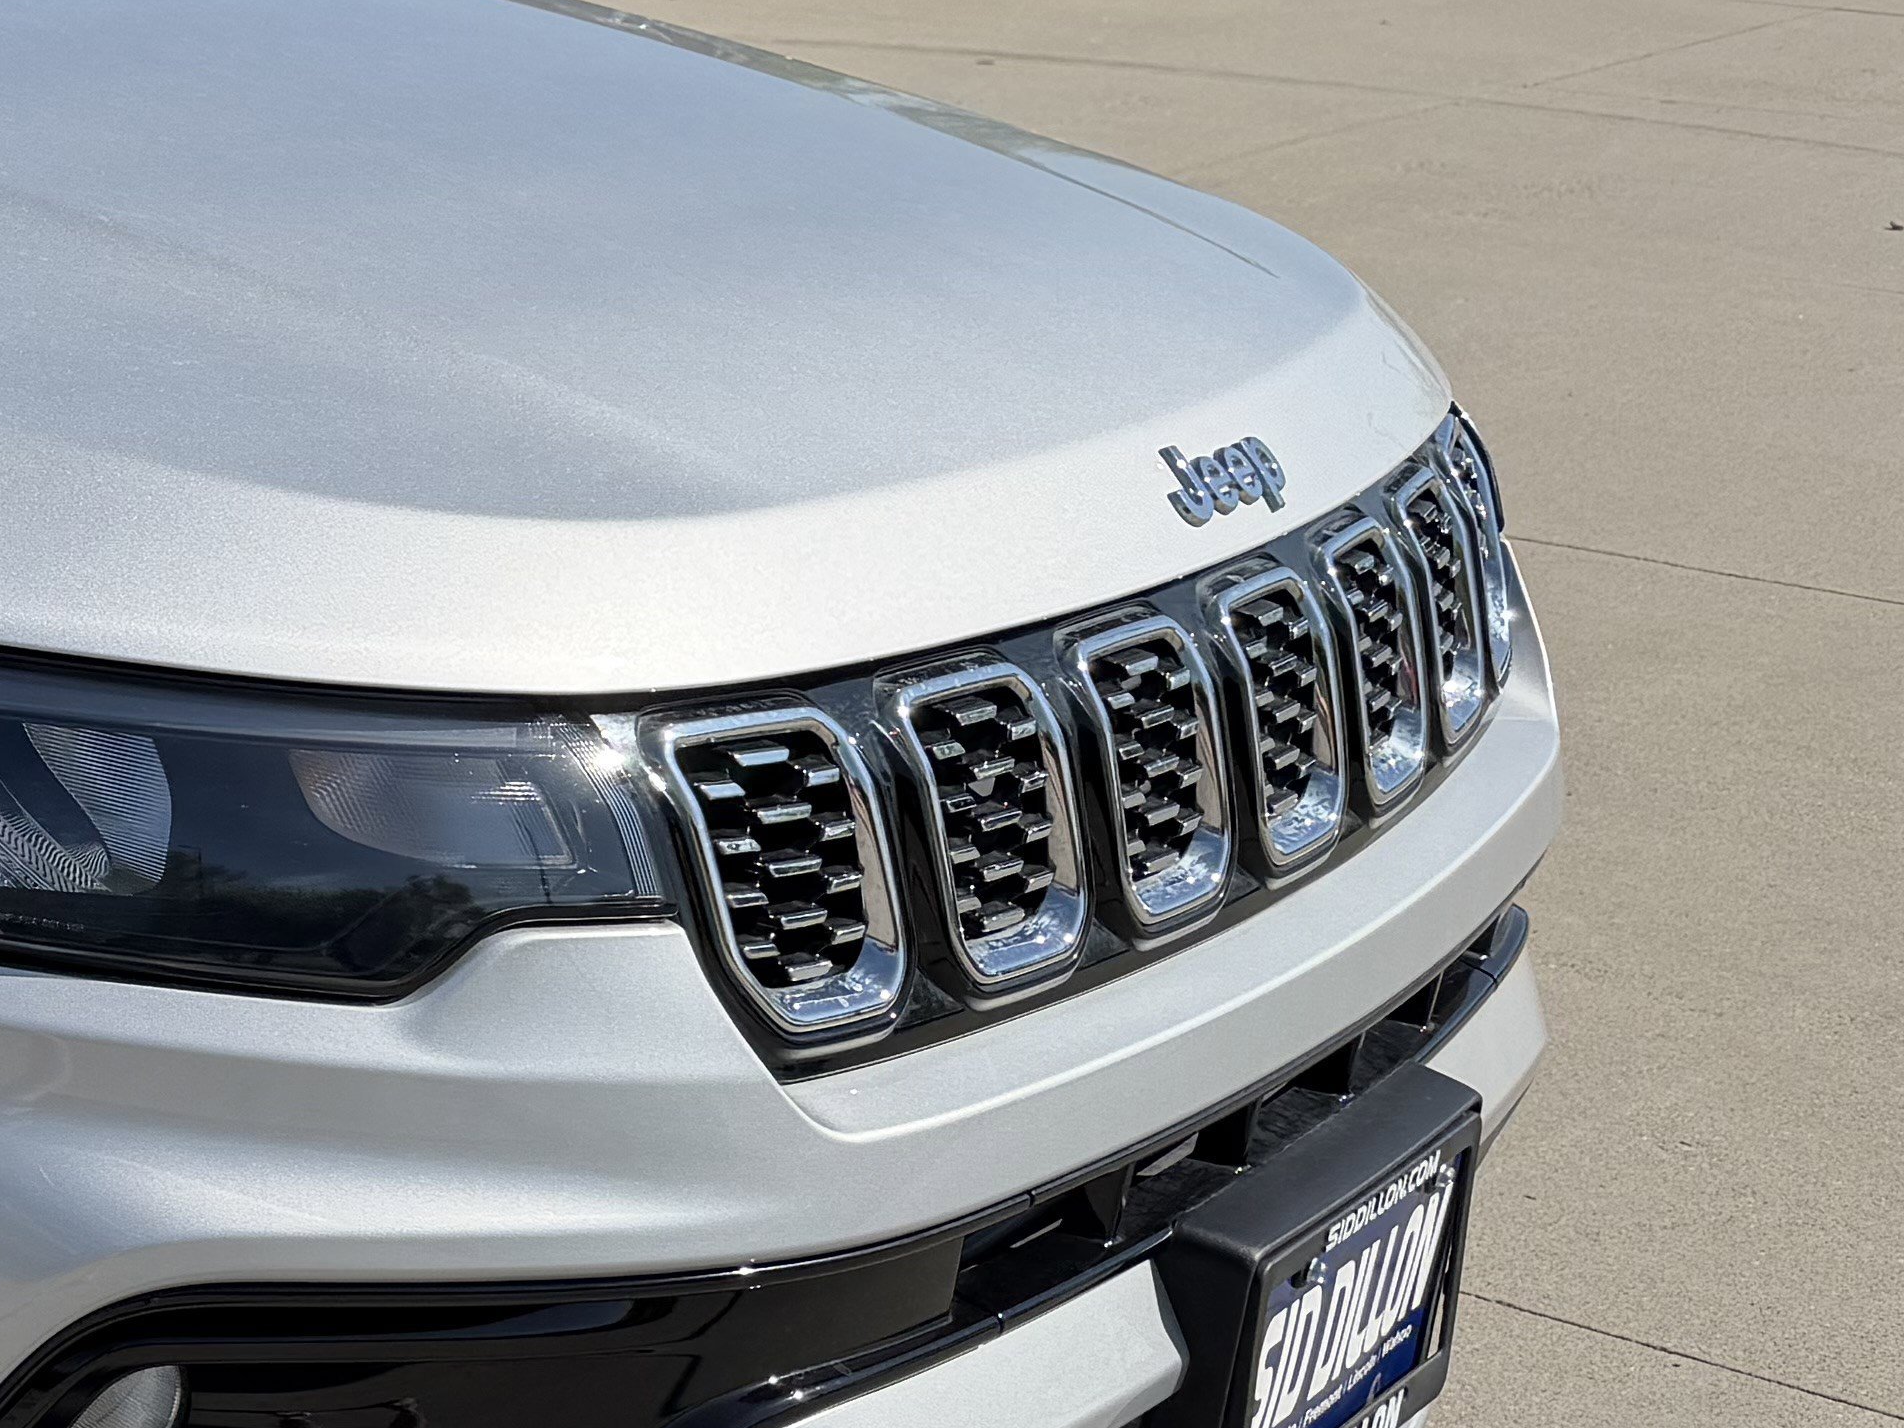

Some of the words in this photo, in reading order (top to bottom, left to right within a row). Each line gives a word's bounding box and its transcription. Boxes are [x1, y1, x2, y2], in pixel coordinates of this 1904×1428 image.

[1158, 436, 1287, 528] Jeep
[1325, 1149, 1442, 1253] SIDDILLON.COM
[1307, 1181, 1454, 1401] DILLON
